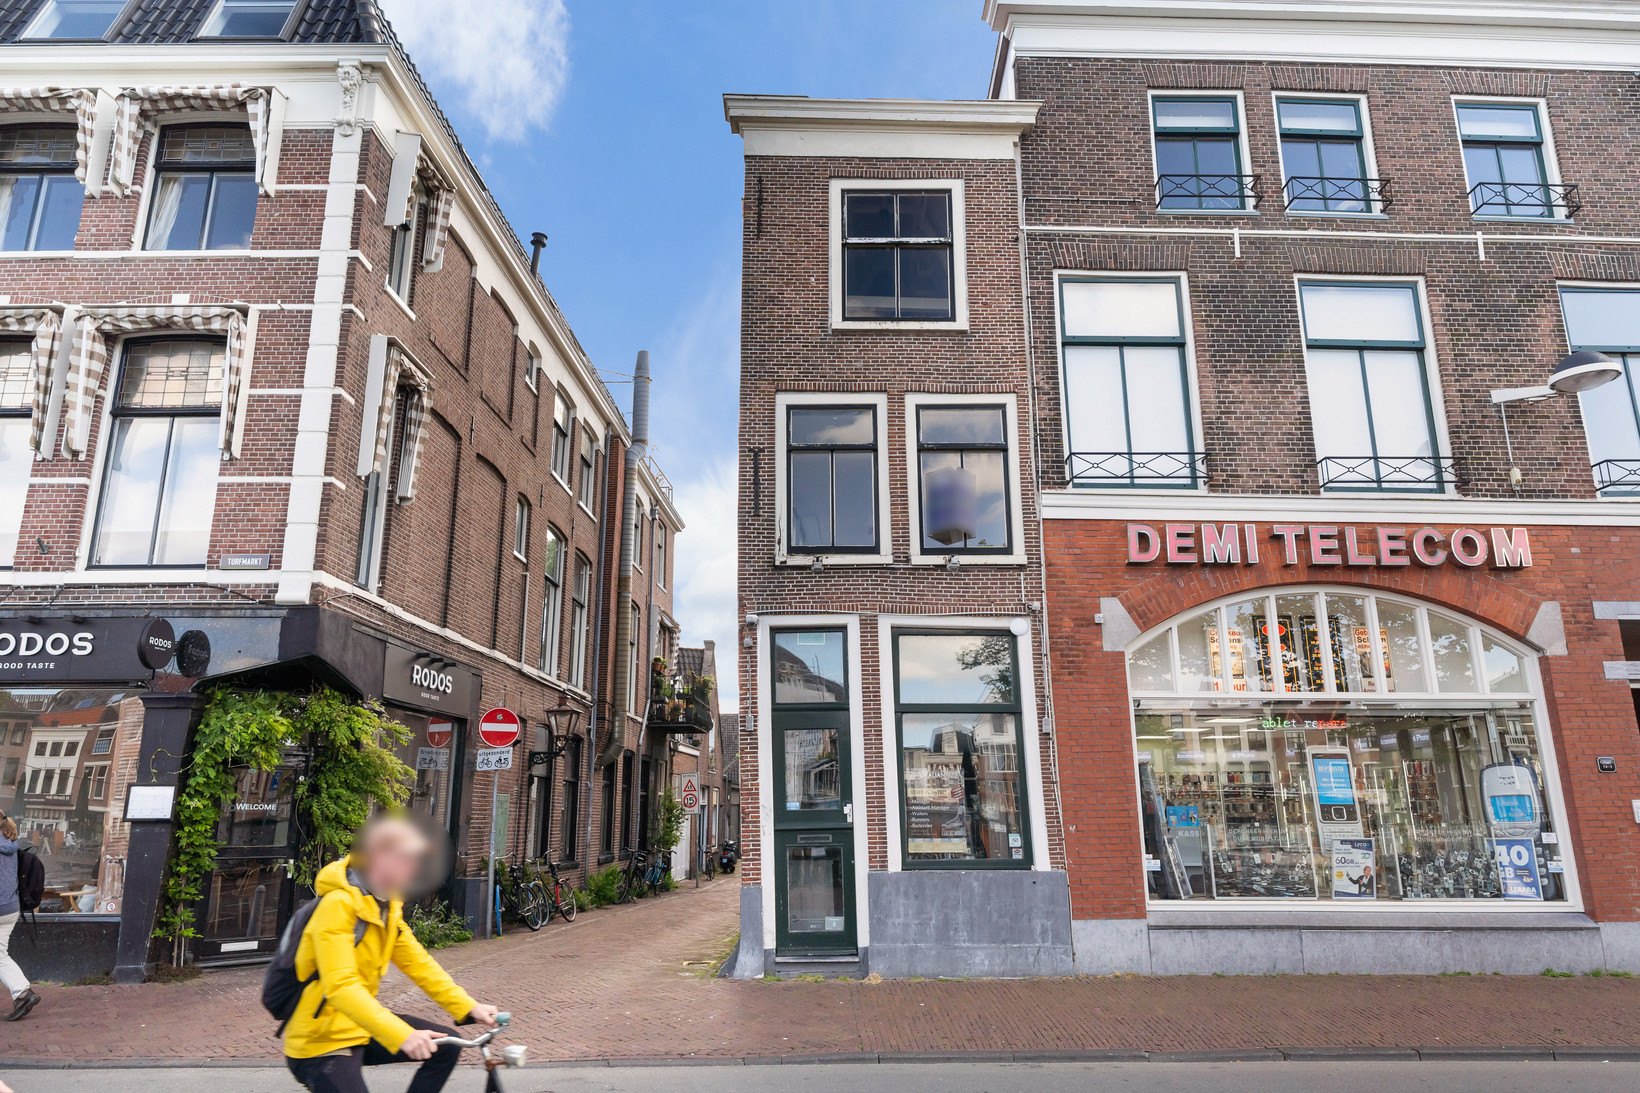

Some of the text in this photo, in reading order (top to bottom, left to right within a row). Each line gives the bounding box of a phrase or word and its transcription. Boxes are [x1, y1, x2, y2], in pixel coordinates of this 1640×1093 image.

[1126, 523, 1533, 568] DEMI TELECOM
[227, 557, 263, 566] TURFMARKT
[0, 632, 95, 656] ODOS
[149, 636, 172, 649] RODOS
[413, 664, 453, 694] RODOS
[1259, 716, 1297, 728] ablet
[478, 749, 510, 758] uitgezonderd
[685, 796, 695, 806] 15
[236, 802, 278, 811] WELCOME
[1335, 857, 1355, 865] 60GB
[1509, 886, 1537, 894] LEBARA
